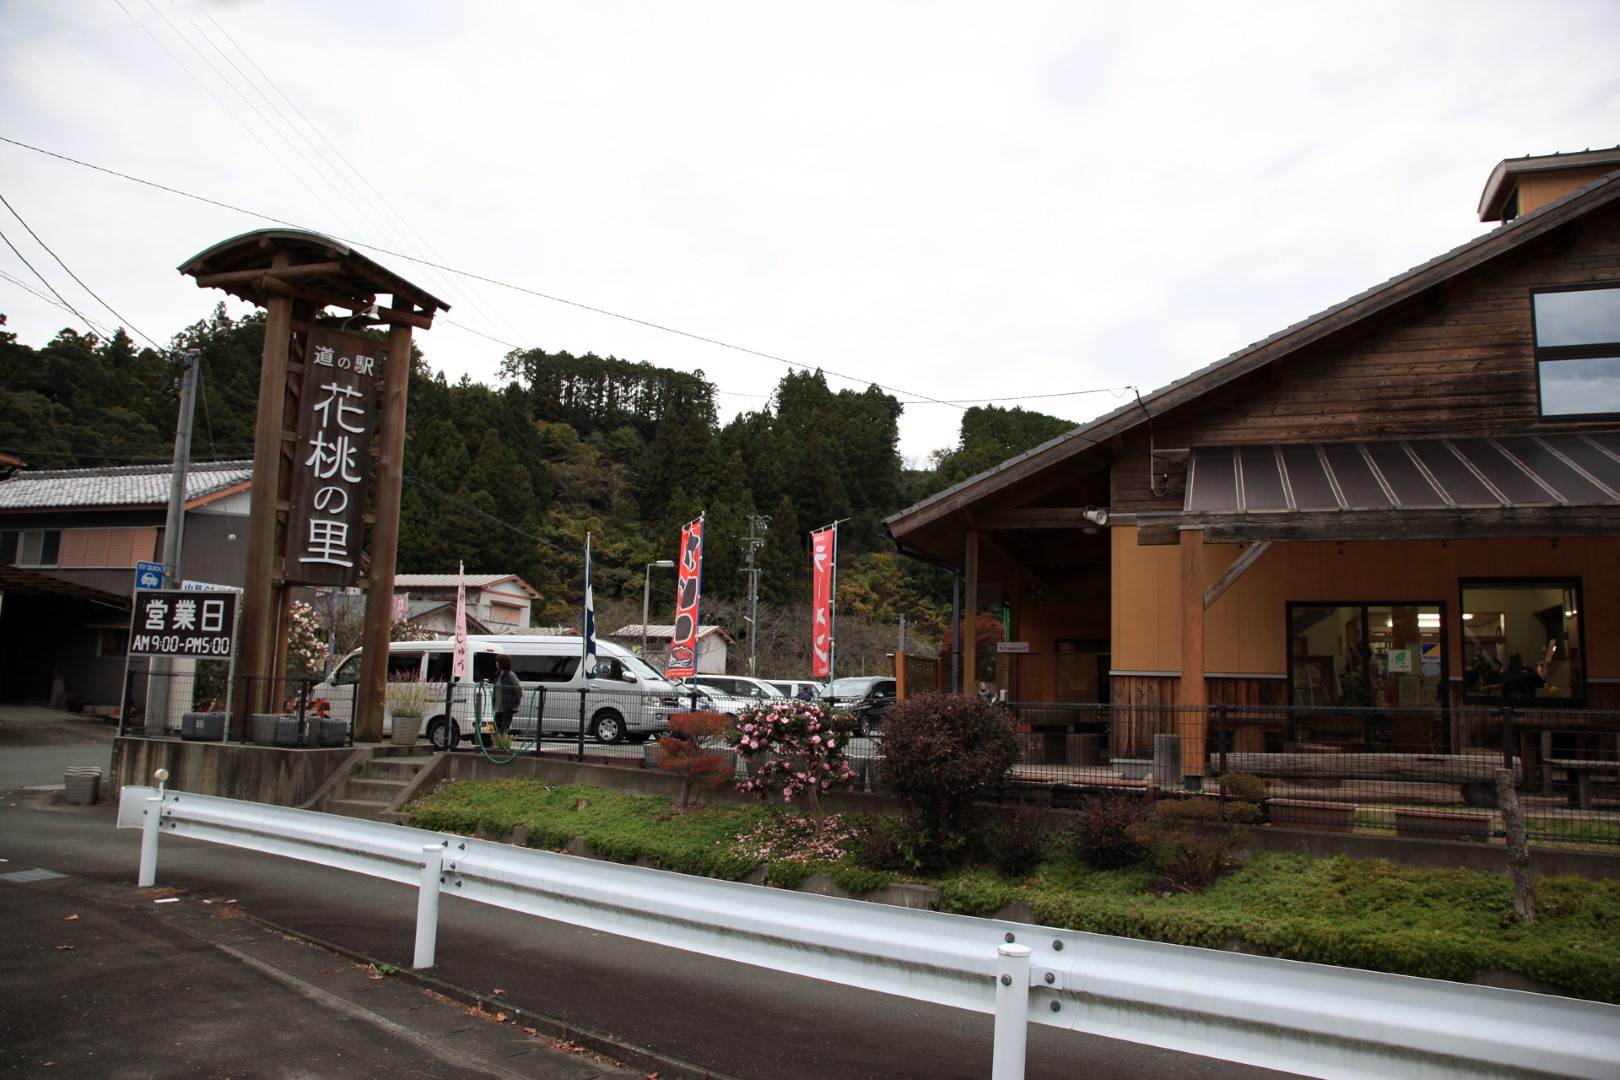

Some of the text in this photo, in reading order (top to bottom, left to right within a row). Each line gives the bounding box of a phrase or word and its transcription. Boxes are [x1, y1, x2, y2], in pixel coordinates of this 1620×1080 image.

[313, 345, 374, 376] 道の駅
[299, 382, 365, 567] 花桃の里
[145, 599, 224, 631] 営業日
